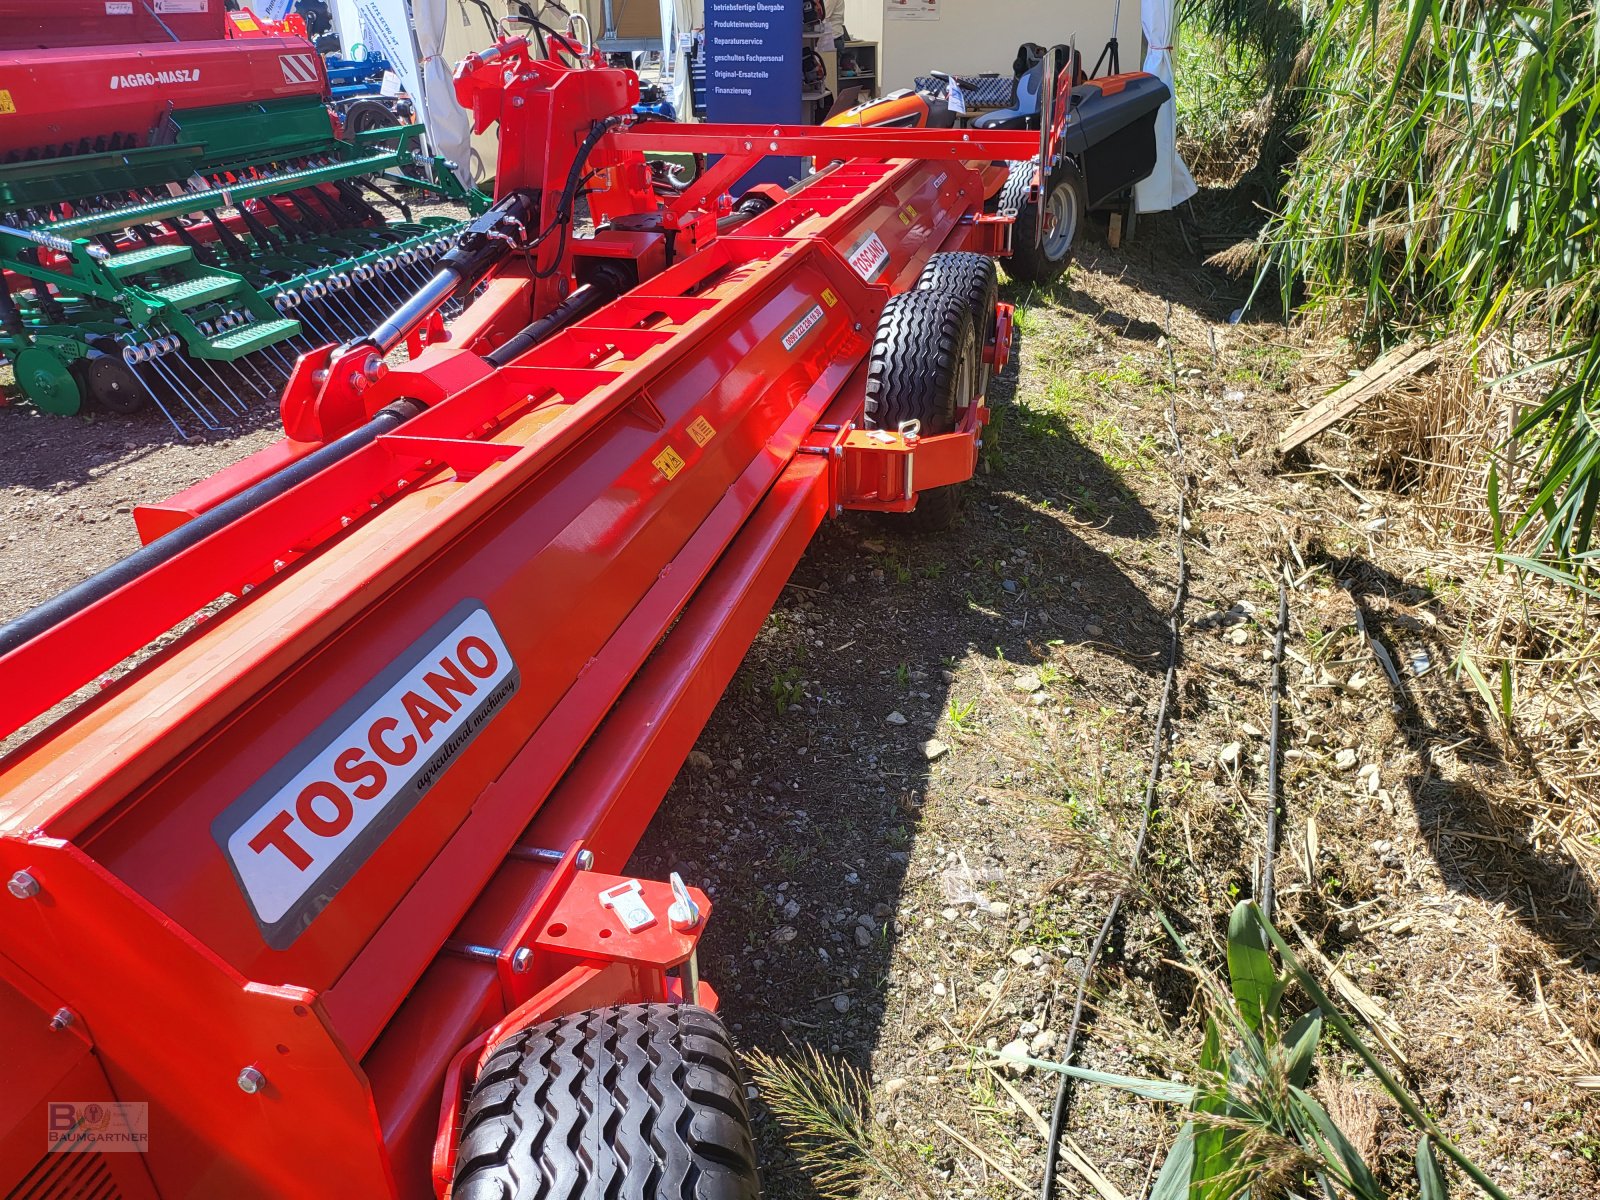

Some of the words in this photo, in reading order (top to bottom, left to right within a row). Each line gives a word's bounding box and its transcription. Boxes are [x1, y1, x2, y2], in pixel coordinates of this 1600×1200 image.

[713, 3, 756, 13] betriebsfertige
[756, 2, 785, 13] Übergabe
[713, 20, 769, 30] Produkteinweisung
[713, 37, 763, 46] Reparaturservice
[714, 53, 745, 63] geschultes
[745, 54, 784, 63] Fachpersonal
[120, 69, 192, 88] AGRO-MASZ
[714, 70, 769, 79] Original-Ersatzteile
[714, 86, 752, 96] Finanzierung
[852, 239, 885, 276] TOSCANO
[417, 721, 473, 789] agricultural
[473, 679, 515, 727] machinery
[248, 636, 498, 872] TOSCANO
